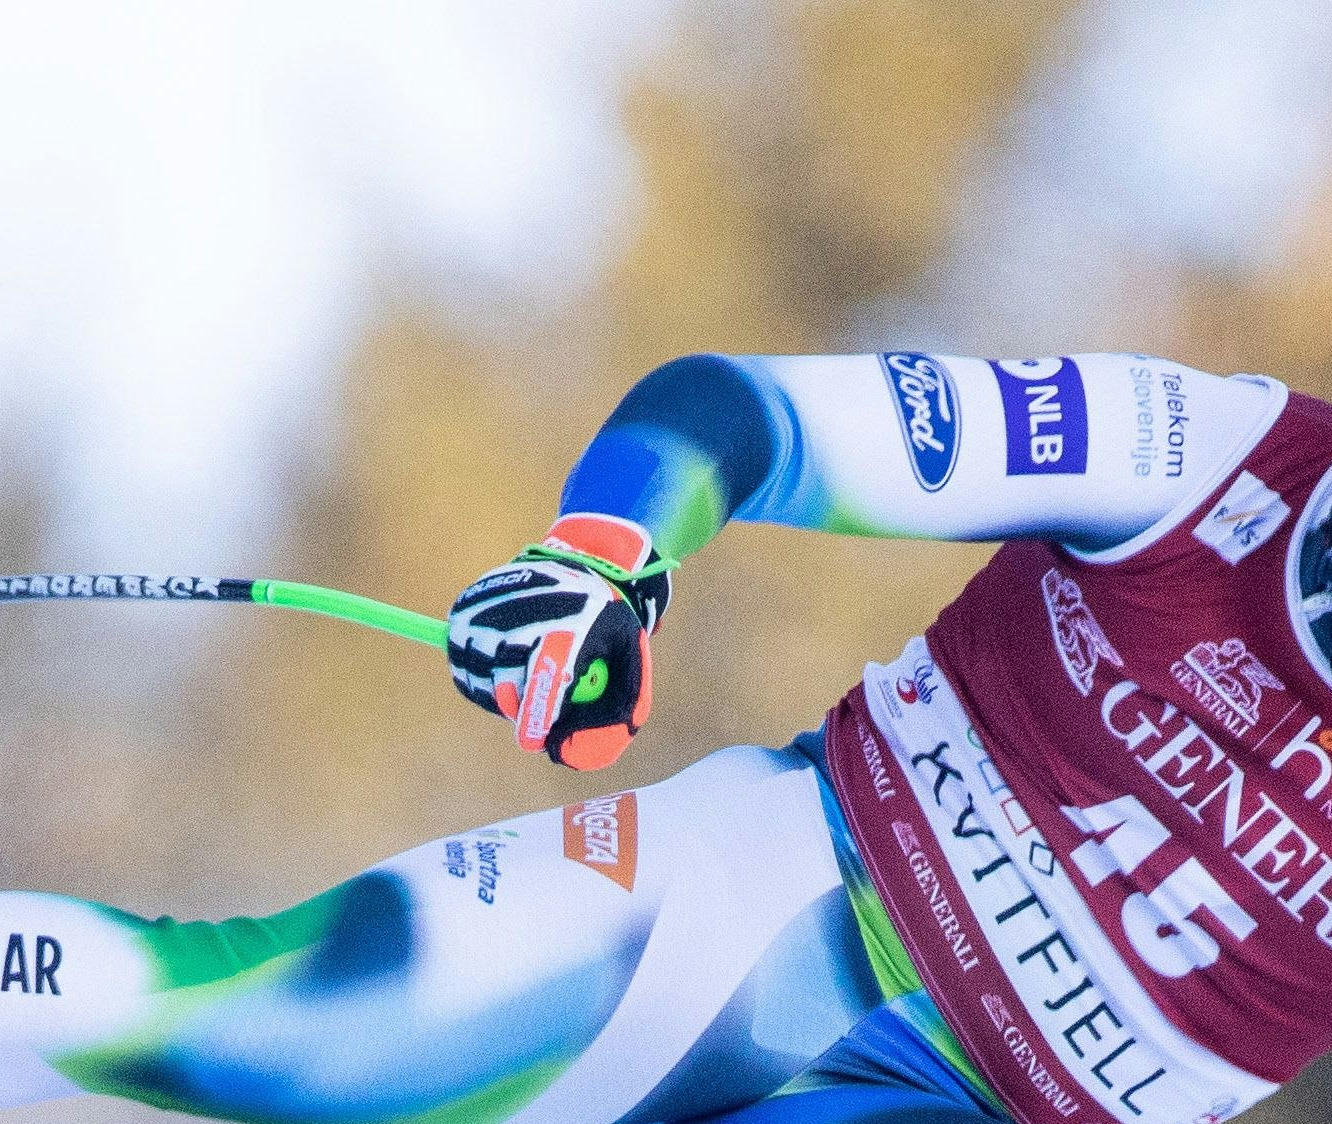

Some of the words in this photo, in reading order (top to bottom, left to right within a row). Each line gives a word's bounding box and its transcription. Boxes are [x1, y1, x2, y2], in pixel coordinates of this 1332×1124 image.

[889, 354, 951, 453] Ford
[1024, 385, 1063, 465] NLB
[1129, 367, 1153, 477] Slovenije
[1159, 371, 1184, 478] Telekom
[1170, 661, 1250, 739] GENERALI
[908, 850, 981, 972] GENERALI
[911, 740, 1166, 1116] KVITFJELL
[1003, 1026, 1081, 1117] GENERALI
